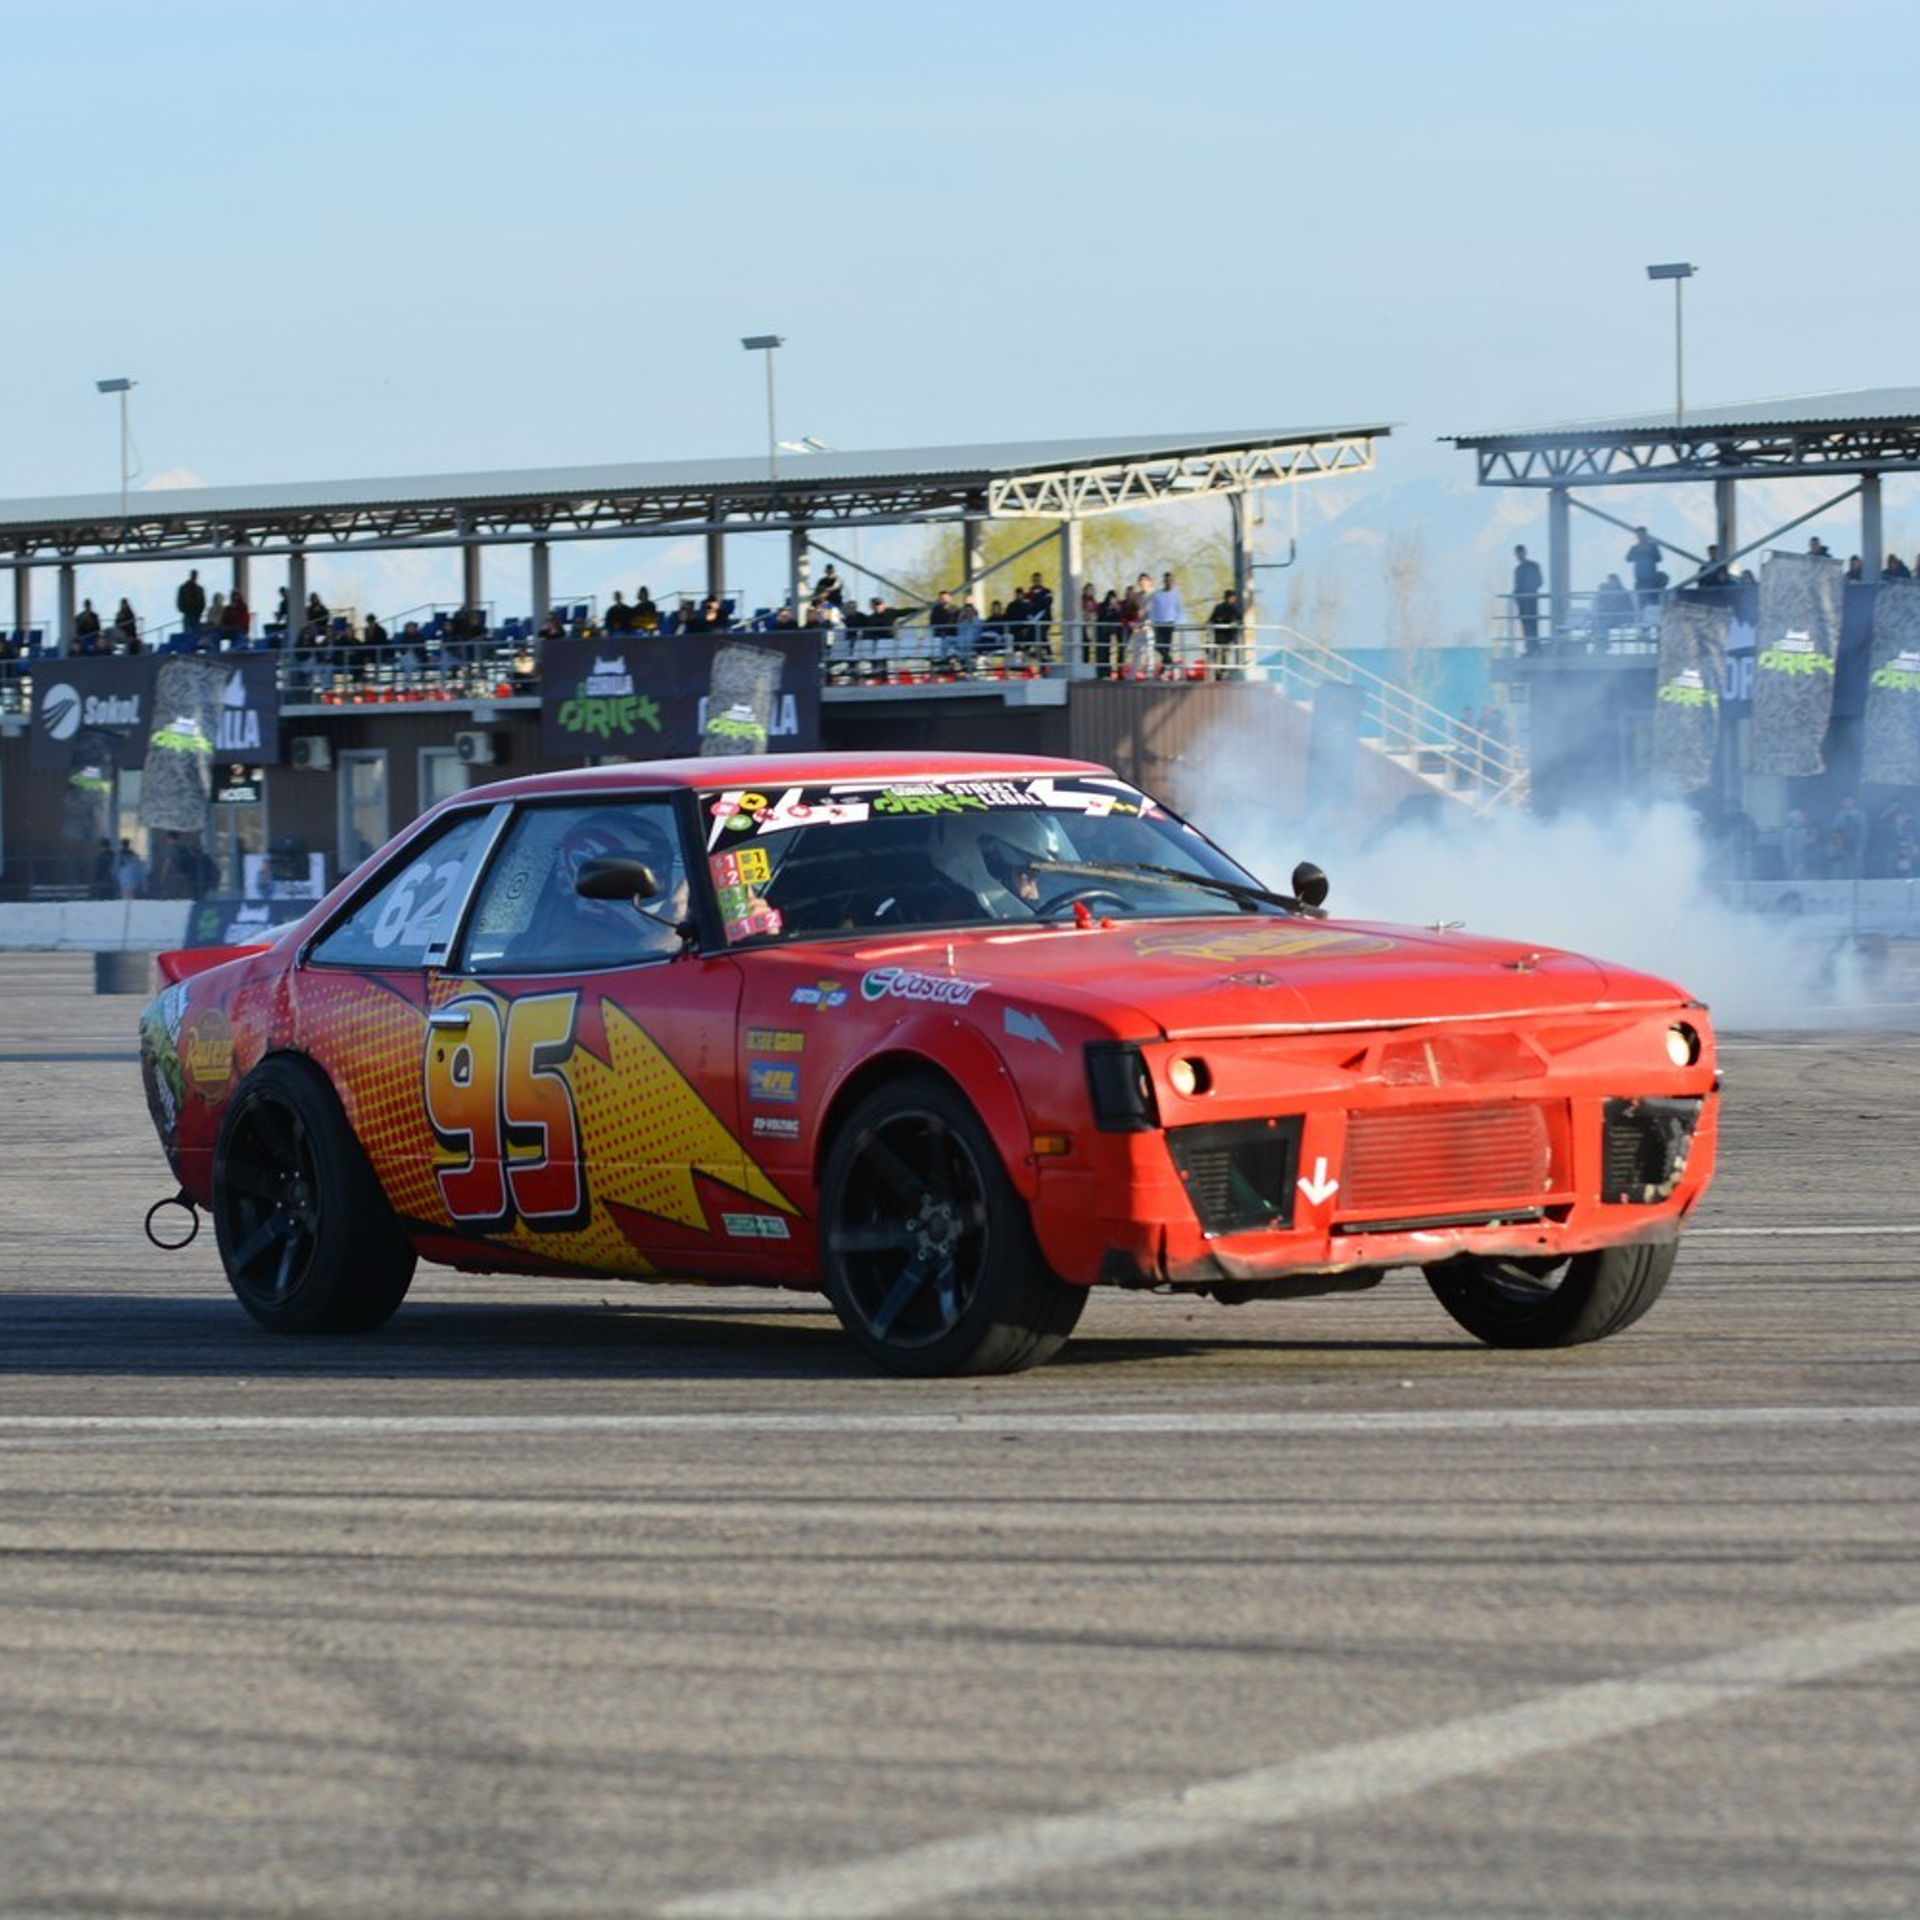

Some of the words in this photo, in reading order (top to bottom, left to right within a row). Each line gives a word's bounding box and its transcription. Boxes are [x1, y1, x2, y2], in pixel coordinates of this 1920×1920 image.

[945, 781, 1017, 795] STREET
[725, 854, 735, 869] 1
[753, 852, 762, 863] 1
[727, 870, 740, 885] 2
[755, 867, 767, 879] 2
[373, 860, 462, 948] 62
[736, 903, 747, 918] 2
[740, 920, 750, 934] 1
[766, 912, 778, 927] 2
[889, 971, 989, 1004] Castrol
[424, 992, 581, 1220] 95
